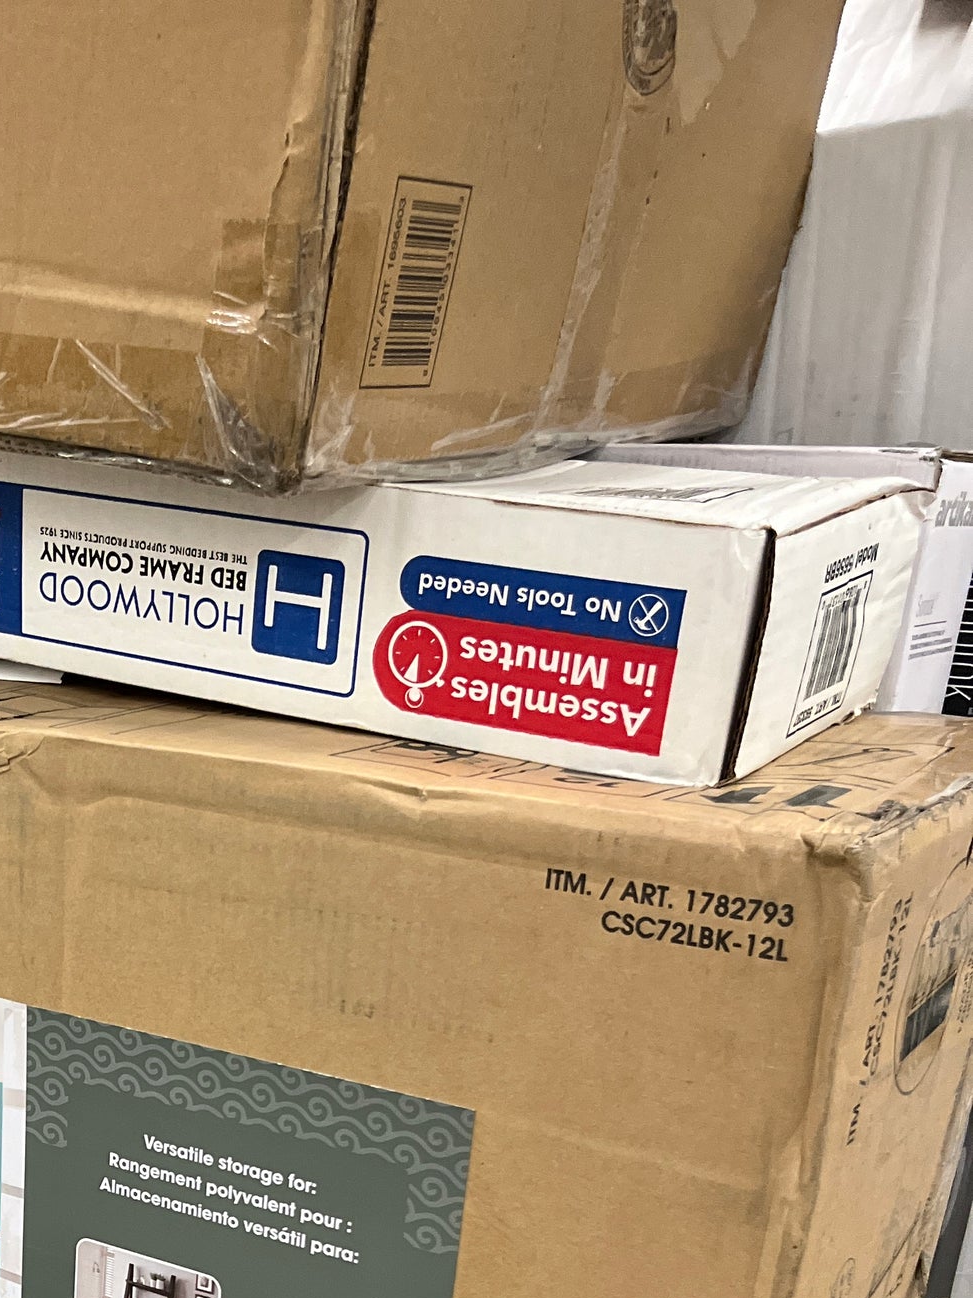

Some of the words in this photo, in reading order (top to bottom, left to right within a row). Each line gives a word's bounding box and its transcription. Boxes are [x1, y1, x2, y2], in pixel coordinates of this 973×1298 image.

[39, 526, 58, 537] 1925
[60, 528, 83, 542] SINCE
[84, 532, 128, 549] PRODUCTS
[129, 539, 167, 554] SUPPORT
[40, 541, 134, 574] COMPANY
[169, 545, 207, 559] BEDDING
[208, 550, 229, 563] BEST
[230, 553, 247, 565] THE
[855, 542, 880, 569] Model
[139, 555, 205, 586] FRAME
[211, 569, 247, 592] BED
[39, 572, 245, 635] HOLLYWOOD
[417, 572, 509, 606] Needed
[516, 586, 577, 616] Tools
[263, 564, 334, 651] H
[584, 596, 622, 623] No
[459, 635, 609, 690] Minutes
[622, 661, 658, 698] in
[450, 675, 651, 738] Assembles
[545, 867, 592, 897] ITM.
[598, 877, 615, 901] /
[619, 880, 673, 910] ART.
[686, 889, 795, 928] 1782793
[600, 910, 789, 962] CSC72LBK-12L
[144, 1134, 213, 1166] Versatile
[218, 1156, 283, 1186] storage
[287, 1174, 317, 1195] for:
[109, 1152, 202, 1191] Rangement
[206, 1182, 296, 1217] polyvalent
[300, 1209, 343, 1230] pour
[346, 1220, 352, 1234] :
[99, 1177, 238, 1228] Almacenamiento
[243, 1220, 306, 1248] versátil
[310, 1238, 359, 1264] para:
